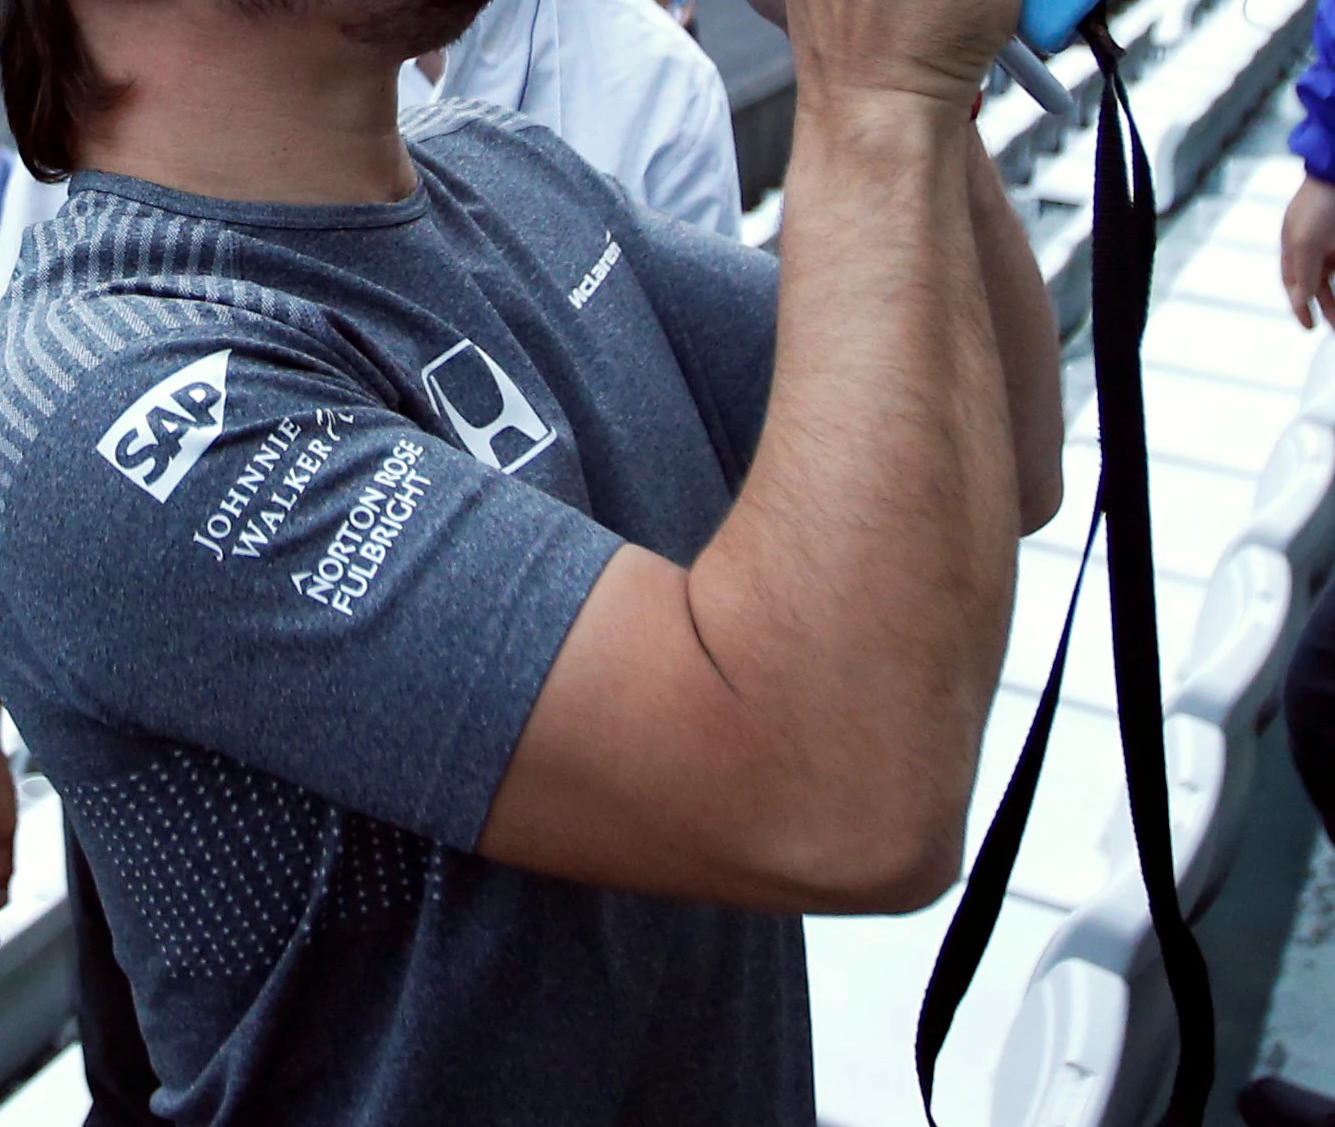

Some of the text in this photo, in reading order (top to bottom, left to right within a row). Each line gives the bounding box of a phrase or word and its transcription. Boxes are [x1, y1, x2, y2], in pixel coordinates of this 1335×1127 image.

[568, 243, 622, 307] McLaren
[114, 381, 222, 487] SAP
[193, 417, 302, 562] JOHNNIE
[231, 438, 333, 558] WALKER
[306, 438, 425, 605] NORTON ROSE
[332, 468, 432, 616] FULBRIGHT
